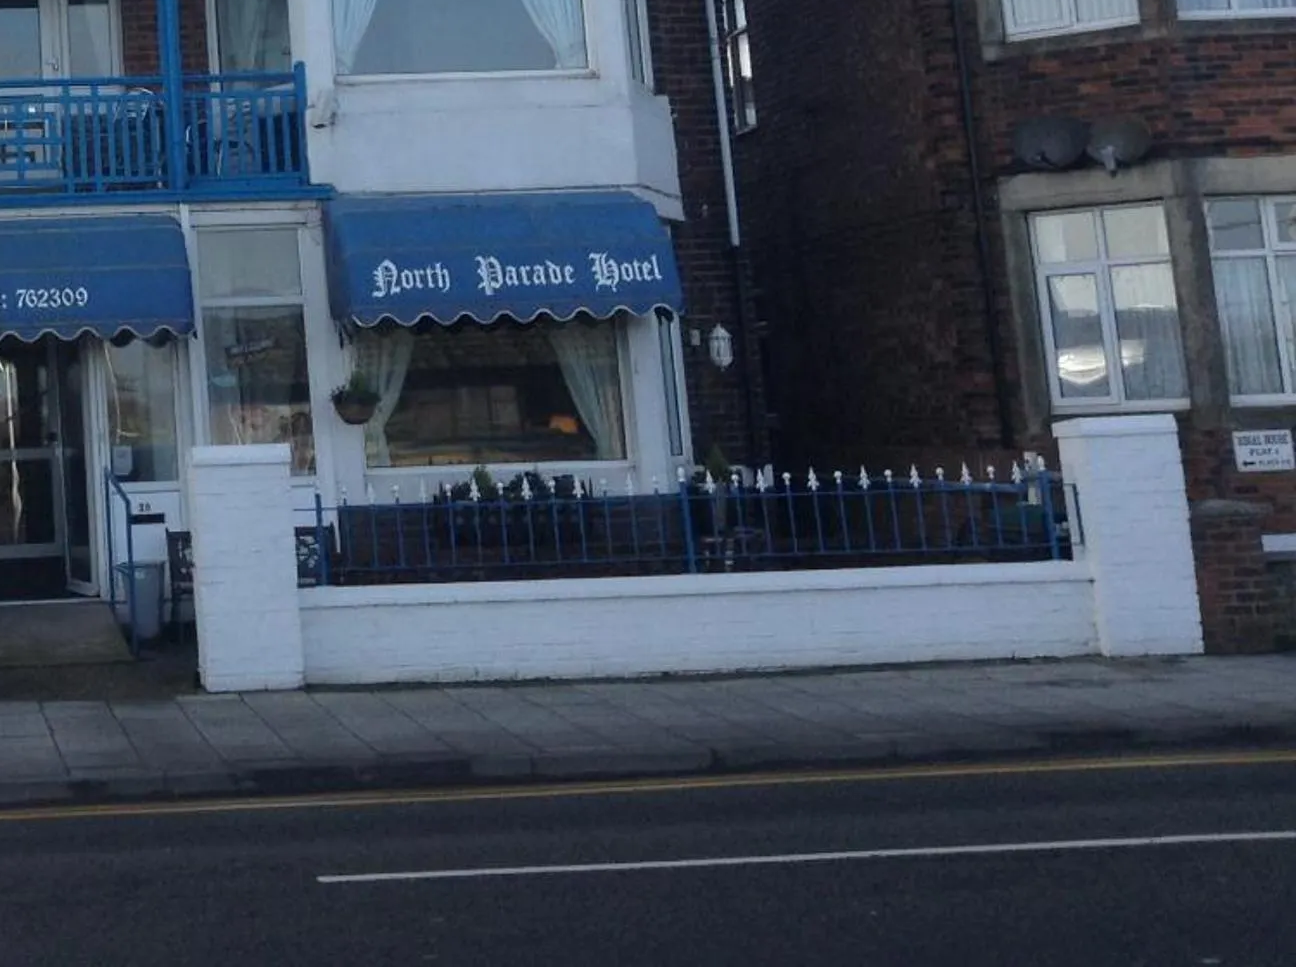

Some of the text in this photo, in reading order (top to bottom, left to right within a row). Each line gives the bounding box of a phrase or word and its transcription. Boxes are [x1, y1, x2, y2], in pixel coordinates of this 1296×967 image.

[371, 250, 663, 298] North Parade Hotel
[15, 286, 89, 309] 762309
